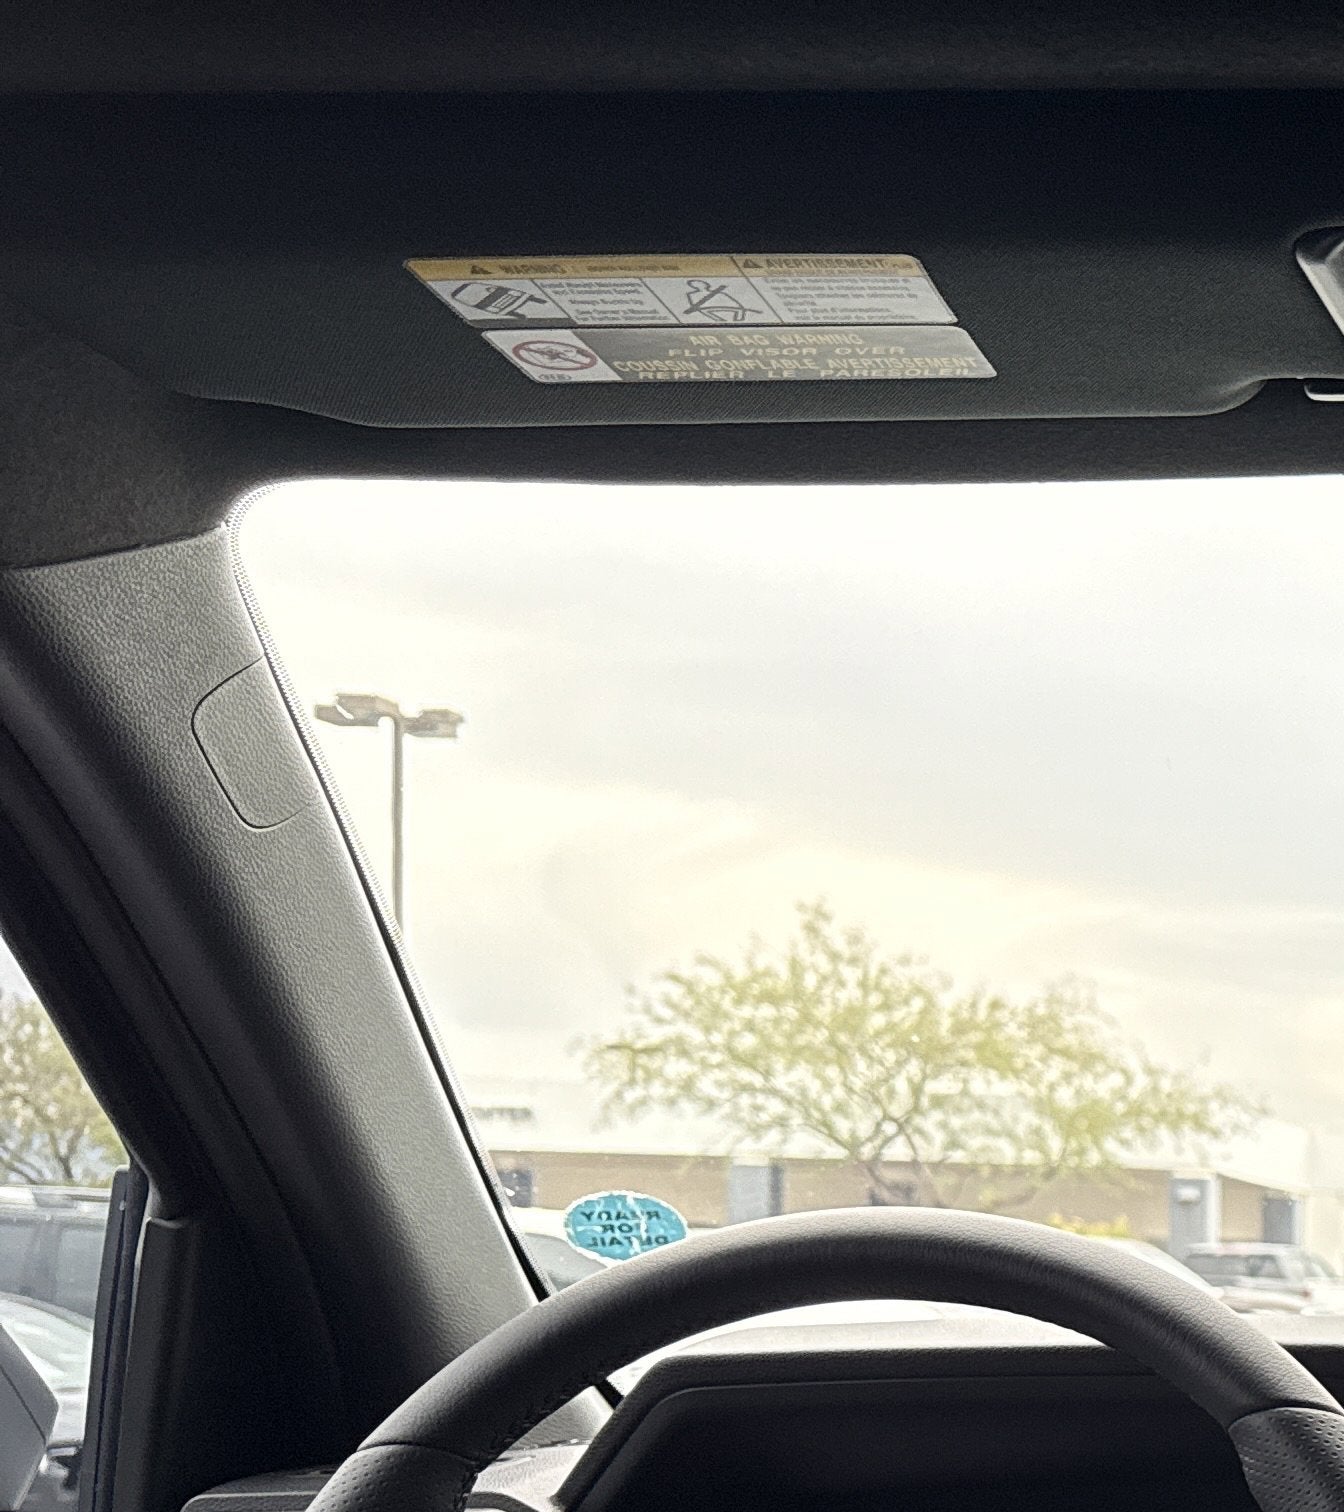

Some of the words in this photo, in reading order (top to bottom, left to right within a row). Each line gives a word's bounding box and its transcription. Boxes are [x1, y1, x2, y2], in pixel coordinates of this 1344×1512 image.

[688, 335, 720, 346] AIR
[727, 334, 769, 346] BAG
[776, 333, 864, 346] WARNING
[668, 348, 724, 357] FLIP
[739, 347, 818, 356] VISOR
[834, 346, 905, 355] OVER
[612, 360, 700, 371] COUSSIN
[704, 358, 820, 371] GONFLABLE
[827, 356, 978, 370] AVERTISSEMENT
[767, 369, 798, 378] LE
